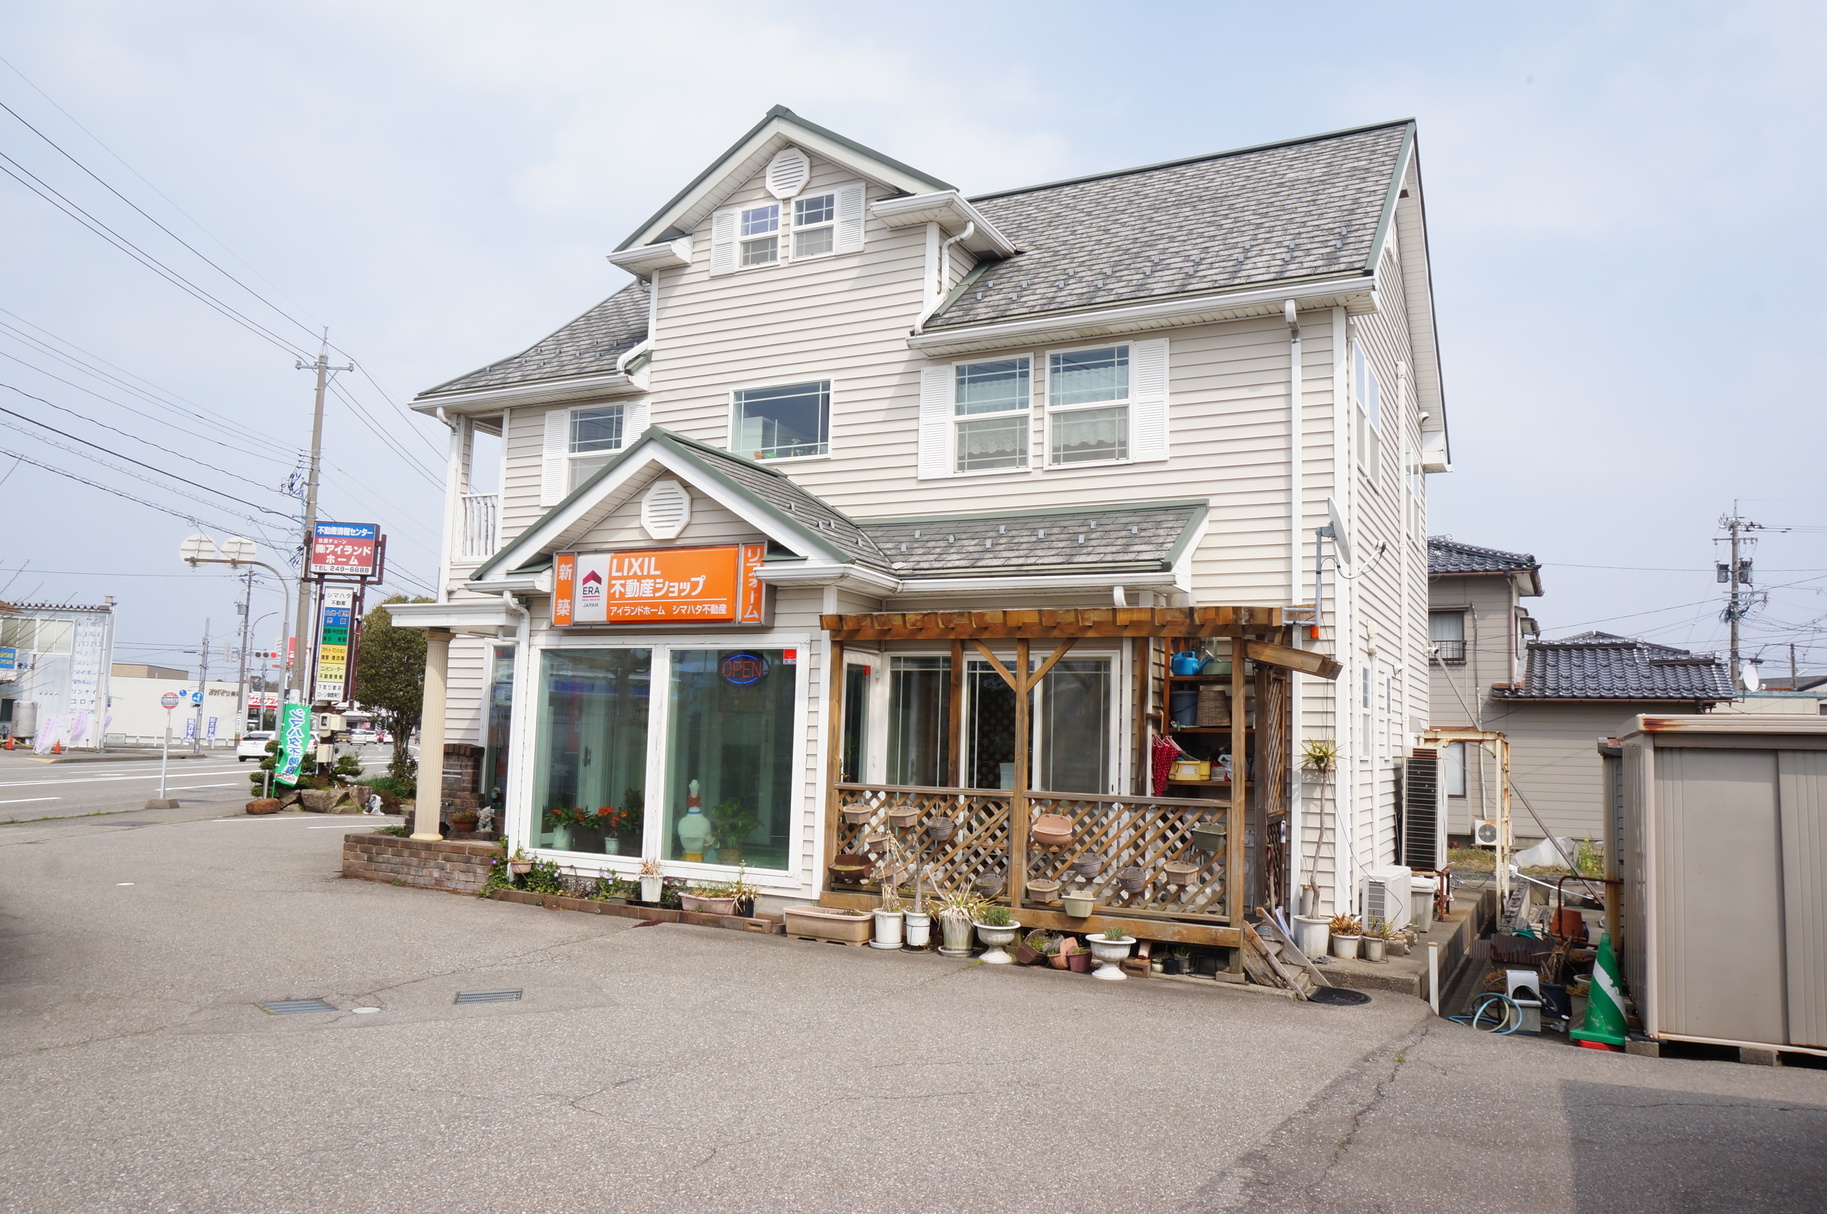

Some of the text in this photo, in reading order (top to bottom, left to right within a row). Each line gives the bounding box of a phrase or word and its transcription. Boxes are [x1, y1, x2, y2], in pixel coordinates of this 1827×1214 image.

[326, 555, 358, 565] ホーム
[611, 557, 661, 576] LIXIL
[557, 563, 573, 616] 新築
[582, 586, 600, 595] ERA
[610, 574, 706, 598] 不動産ショップ
[610, 604, 727, 616] アイランドホーム シマハタ不動産
[722, 661, 762, 678] OPEN
